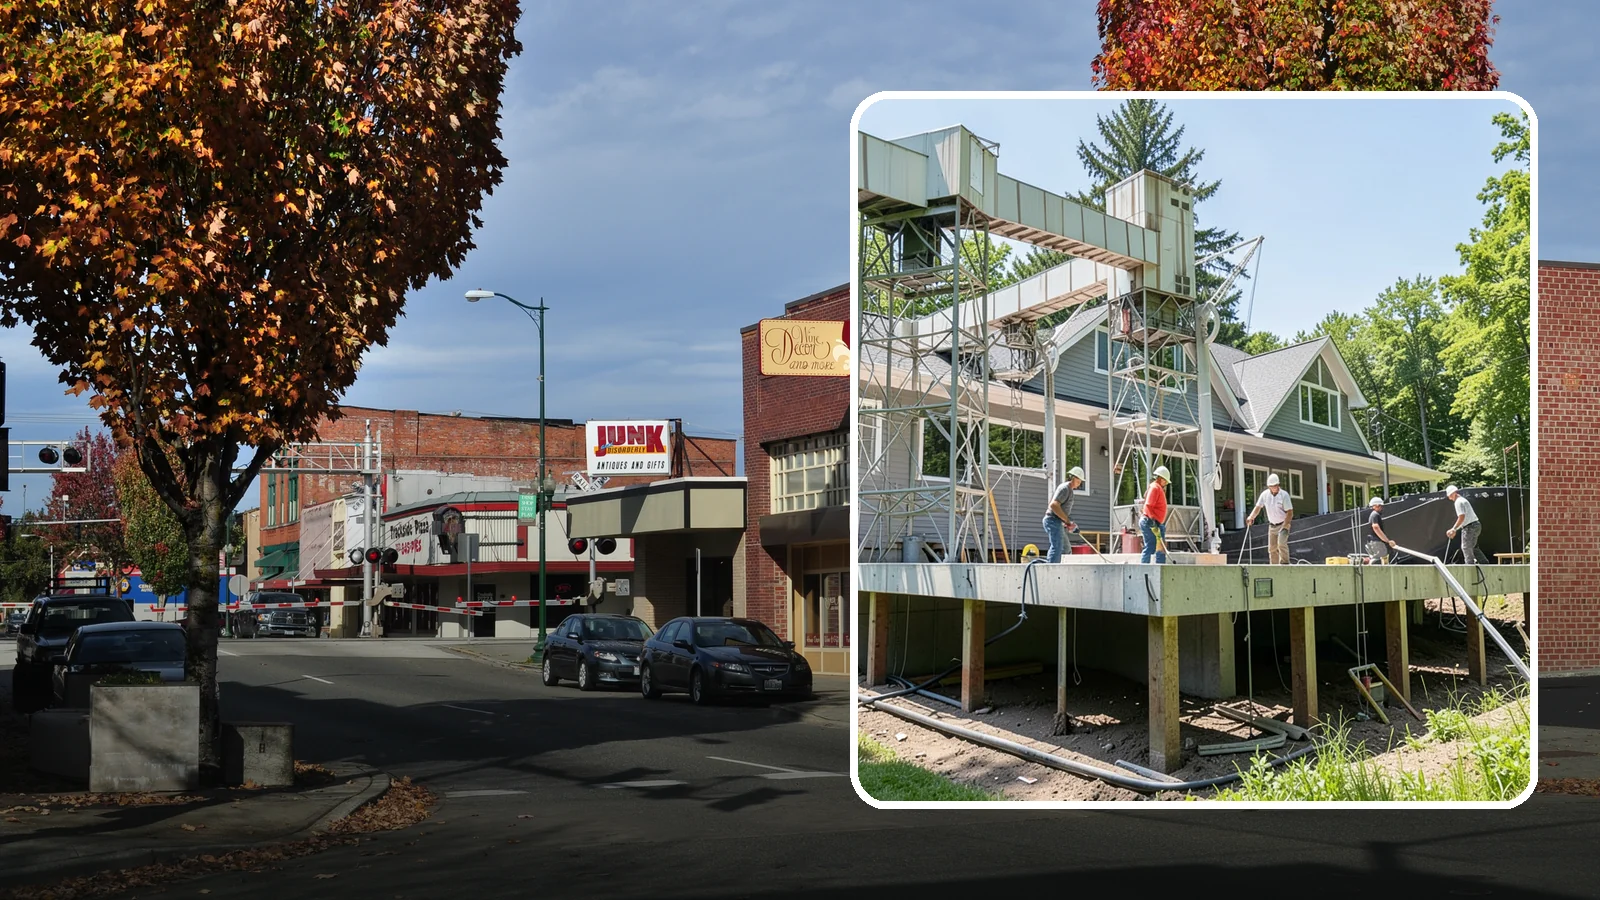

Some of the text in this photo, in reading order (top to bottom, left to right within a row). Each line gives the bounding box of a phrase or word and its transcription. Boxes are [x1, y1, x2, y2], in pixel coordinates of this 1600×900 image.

[765, 328, 831, 365] Decor
[595, 425, 665, 457] JUNK
[607, 446, 646, 454] DISORDERLY
[597, 460, 665, 470] ANTIQUES AND GIFTS
[573, 473, 589, 492] RAIL
[590, 476, 608, 491] SING
[414, 519, 429, 534] Pizza
